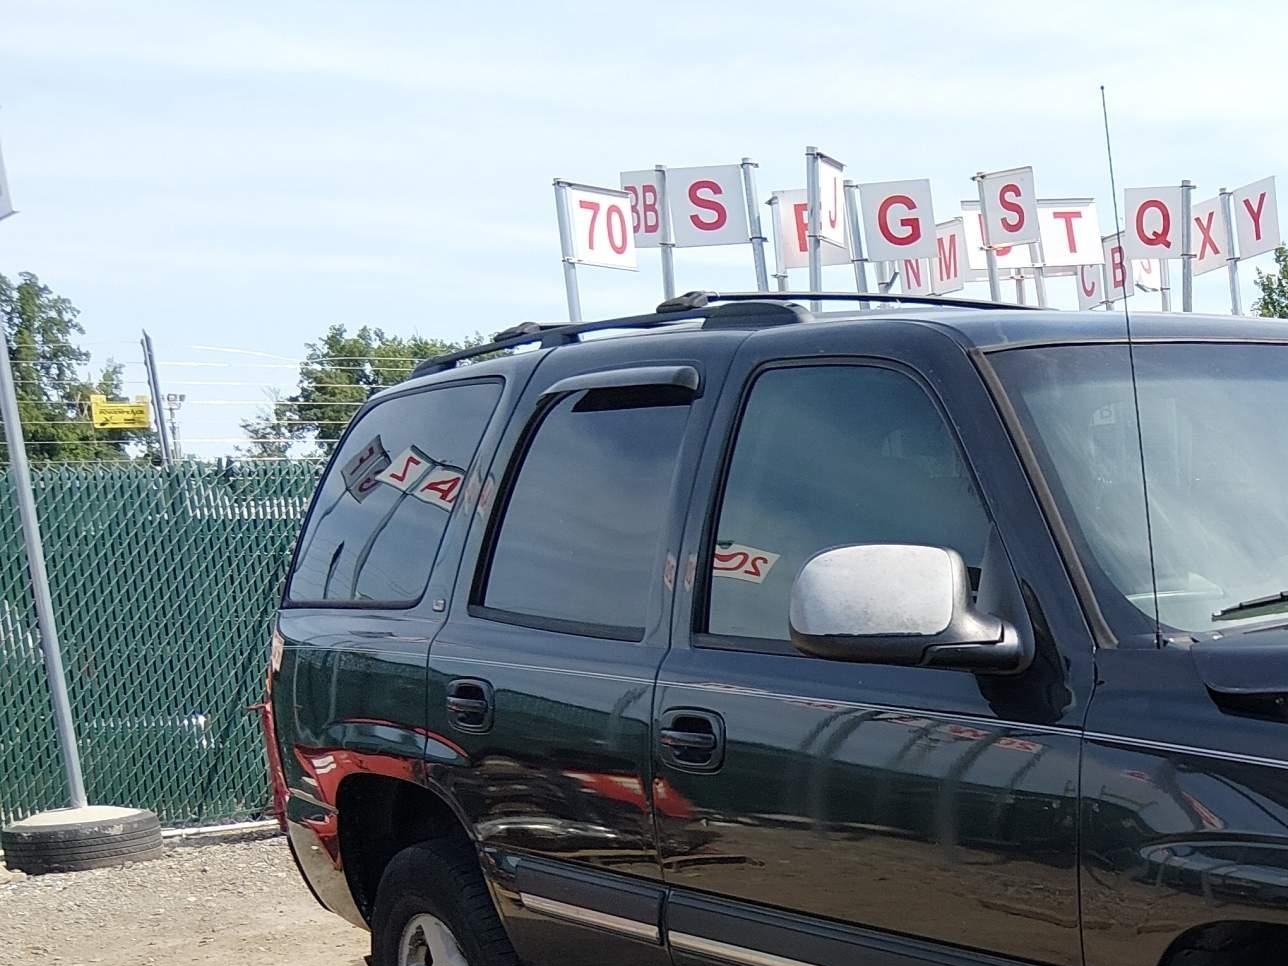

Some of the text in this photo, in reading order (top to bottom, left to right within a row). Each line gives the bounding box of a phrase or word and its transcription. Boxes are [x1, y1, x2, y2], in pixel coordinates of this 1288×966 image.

[579, 200, 628, 255] 70
[688, 180, 728, 232] S
[829, 176, 837, 229] J
[878, 195, 922, 246] G
[999, 183, 1026, 233] S
[1136, 199, 1172, 249] Q
[1243, 192, 1267, 241] Y
[1053, 211, 1083, 254] T
[1194, 211, 1221, 261] X
[904, 258, 922, 290] N
[937, 234, 958, 282] M
[1110, 246, 1126, 289] B
